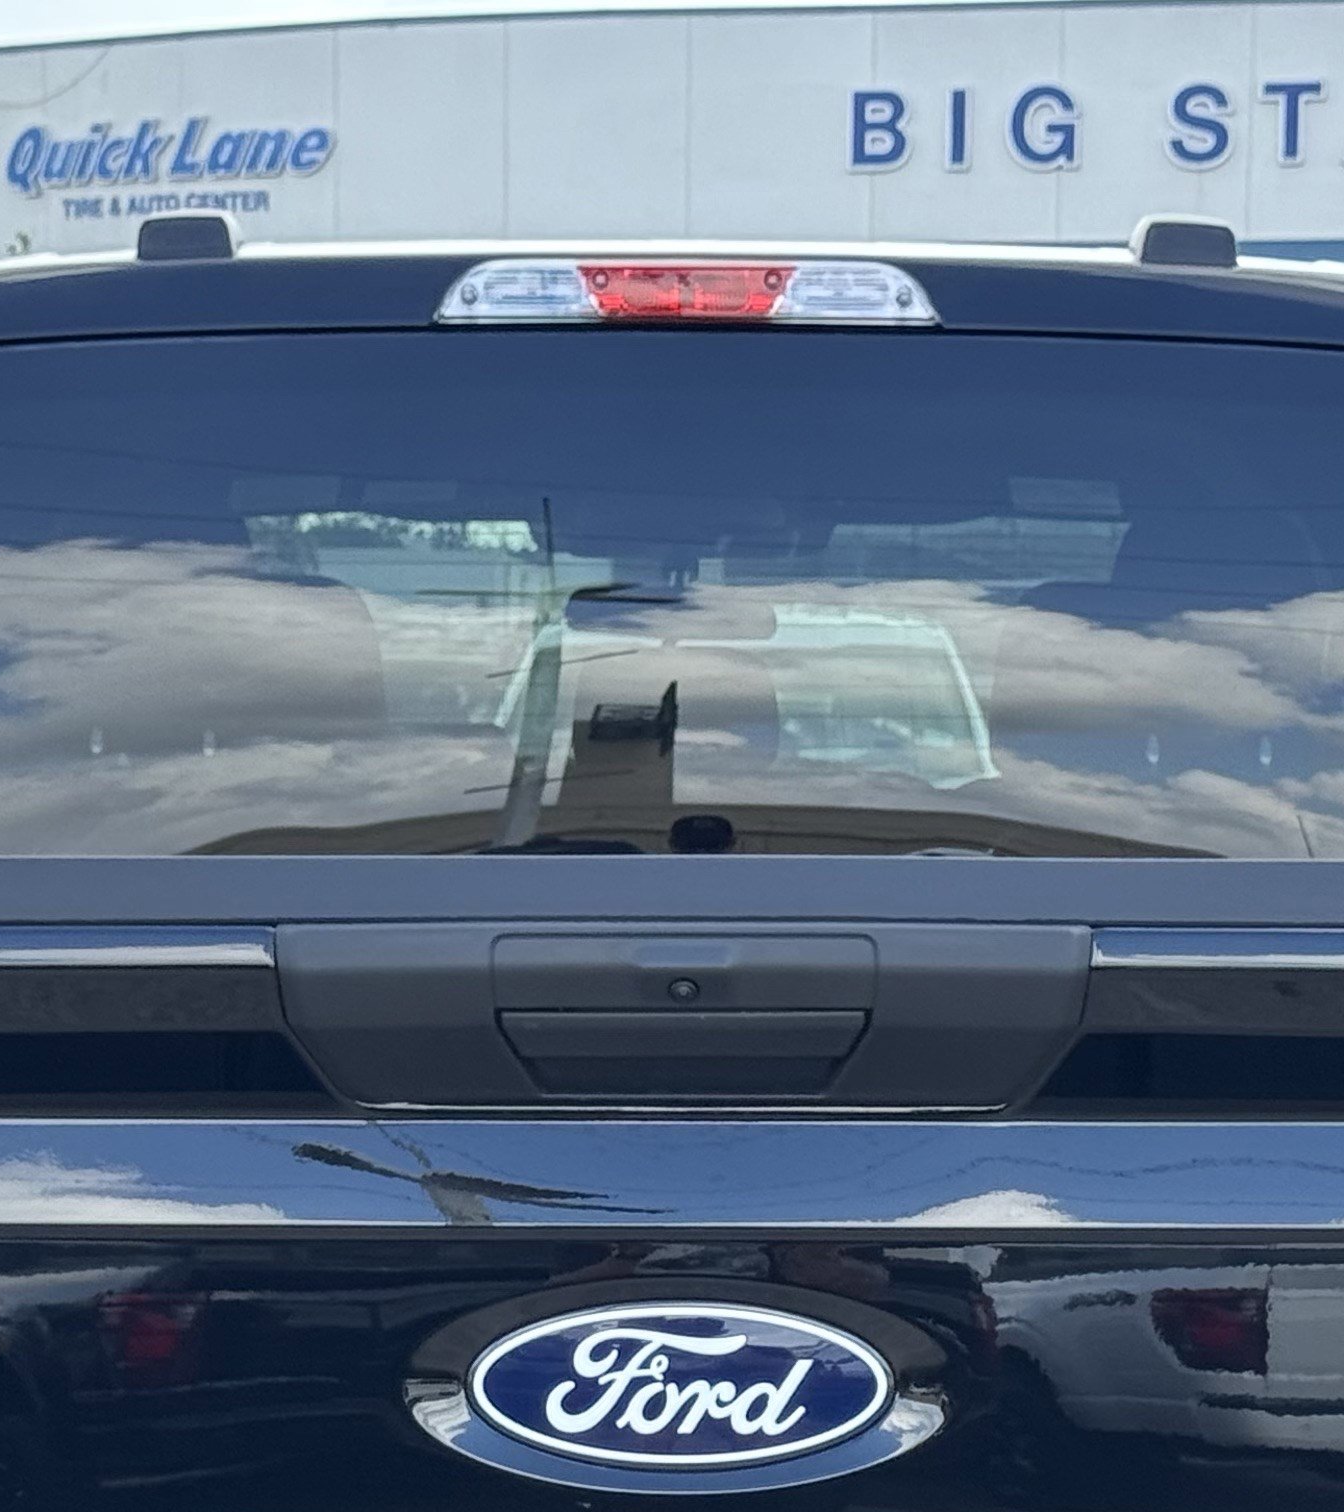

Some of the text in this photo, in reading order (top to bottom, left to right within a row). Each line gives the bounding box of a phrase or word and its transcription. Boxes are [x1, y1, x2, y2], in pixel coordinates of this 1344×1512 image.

[6, 116, 333, 193] Quick Lane
[851, 85, 1077, 167] BIG
[545, 1327, 814, 1436] Ford
